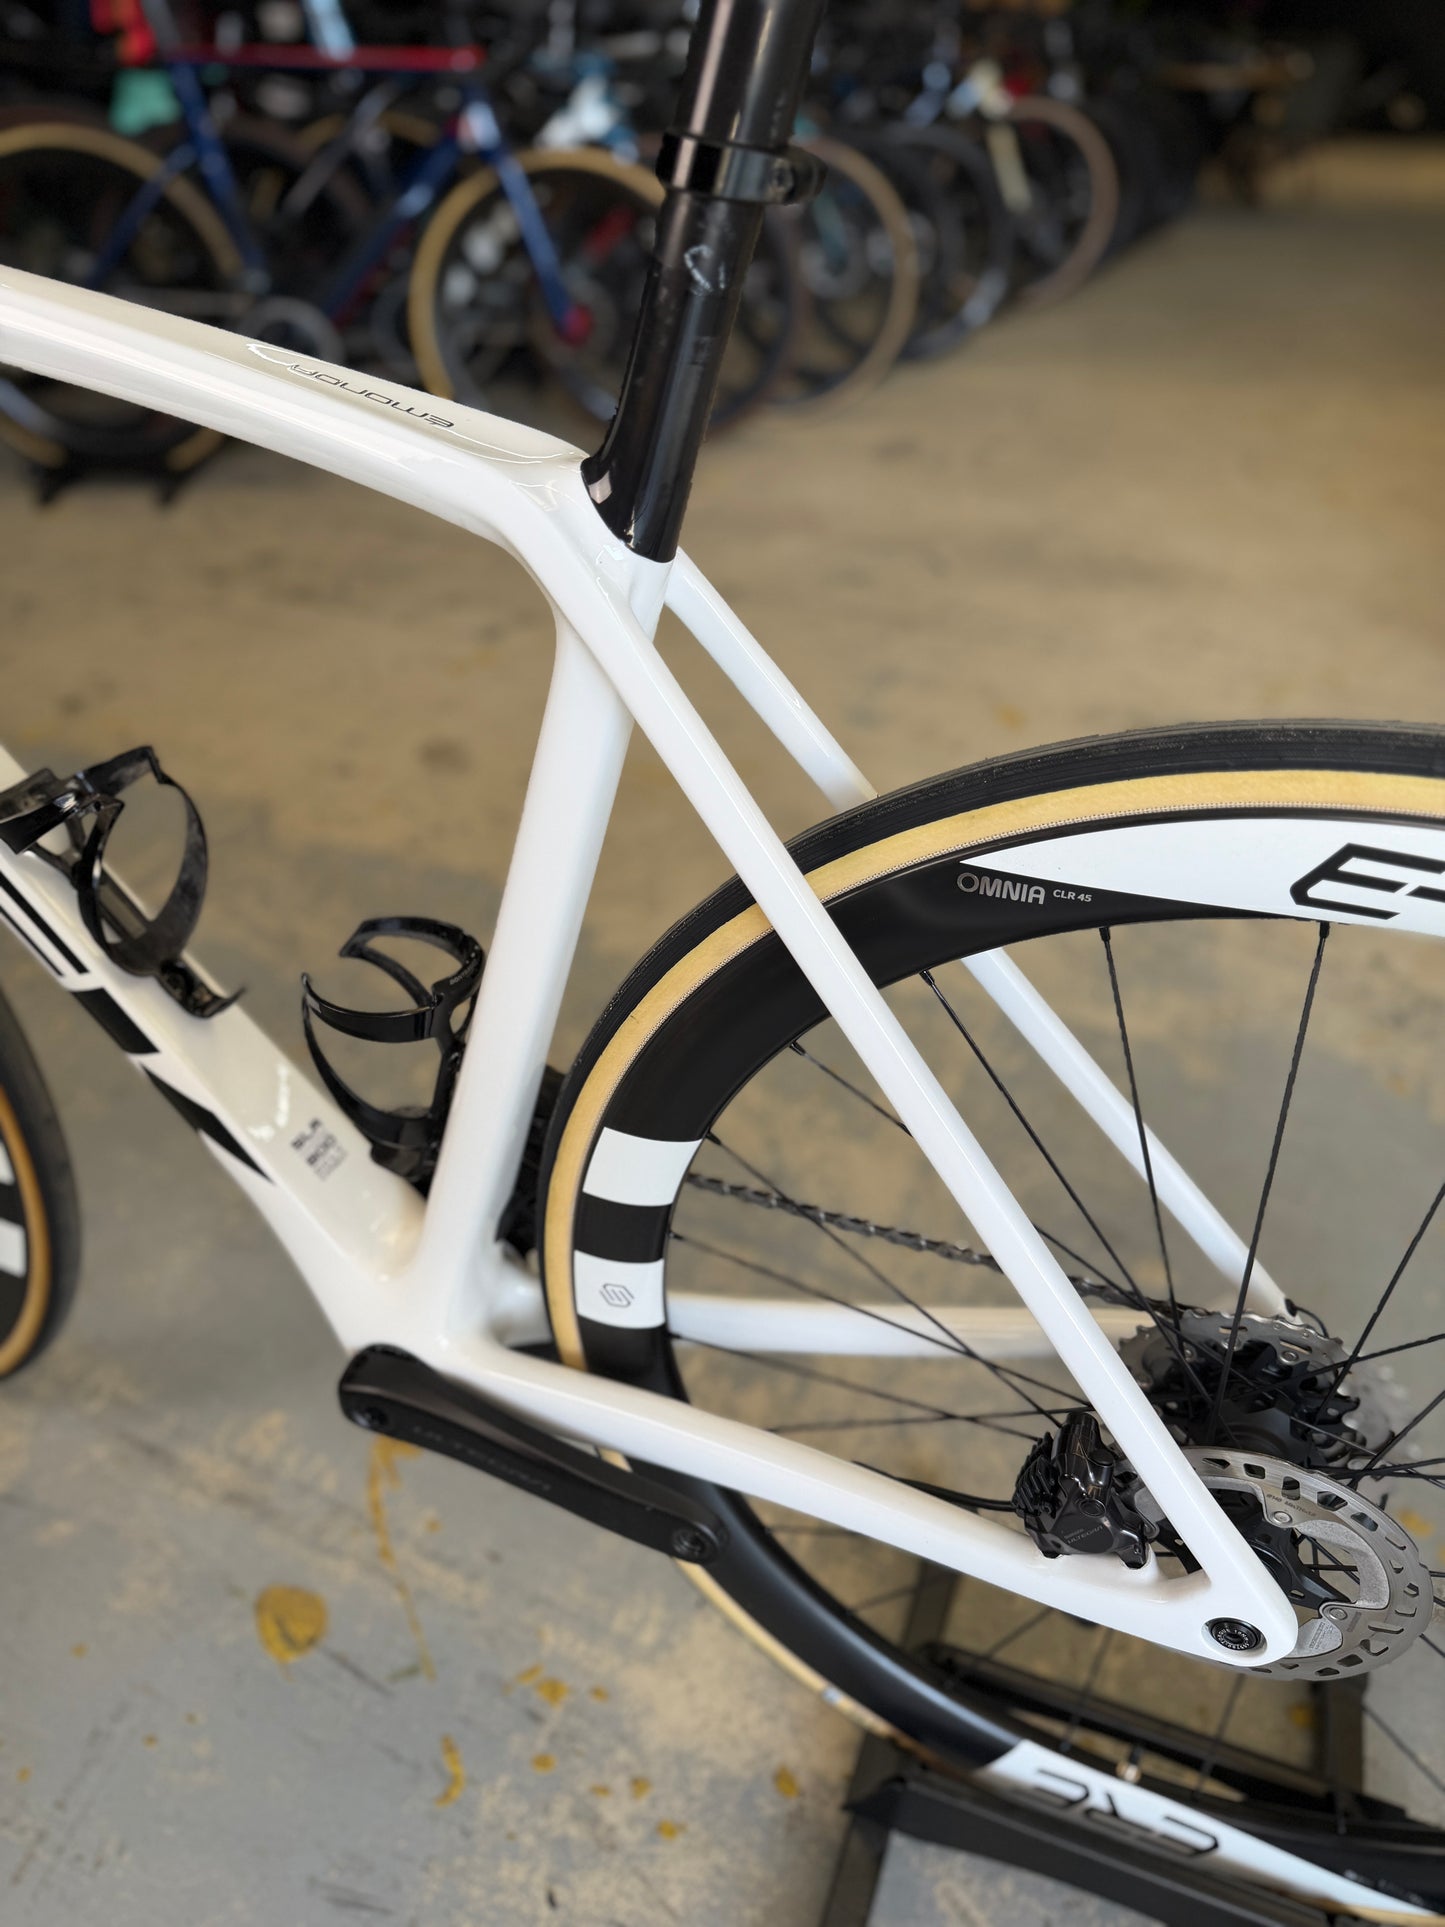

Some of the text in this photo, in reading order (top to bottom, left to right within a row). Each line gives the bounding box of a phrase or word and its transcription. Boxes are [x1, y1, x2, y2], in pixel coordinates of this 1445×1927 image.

[957, 872, 1093, 905] OMNIA CLR 45
